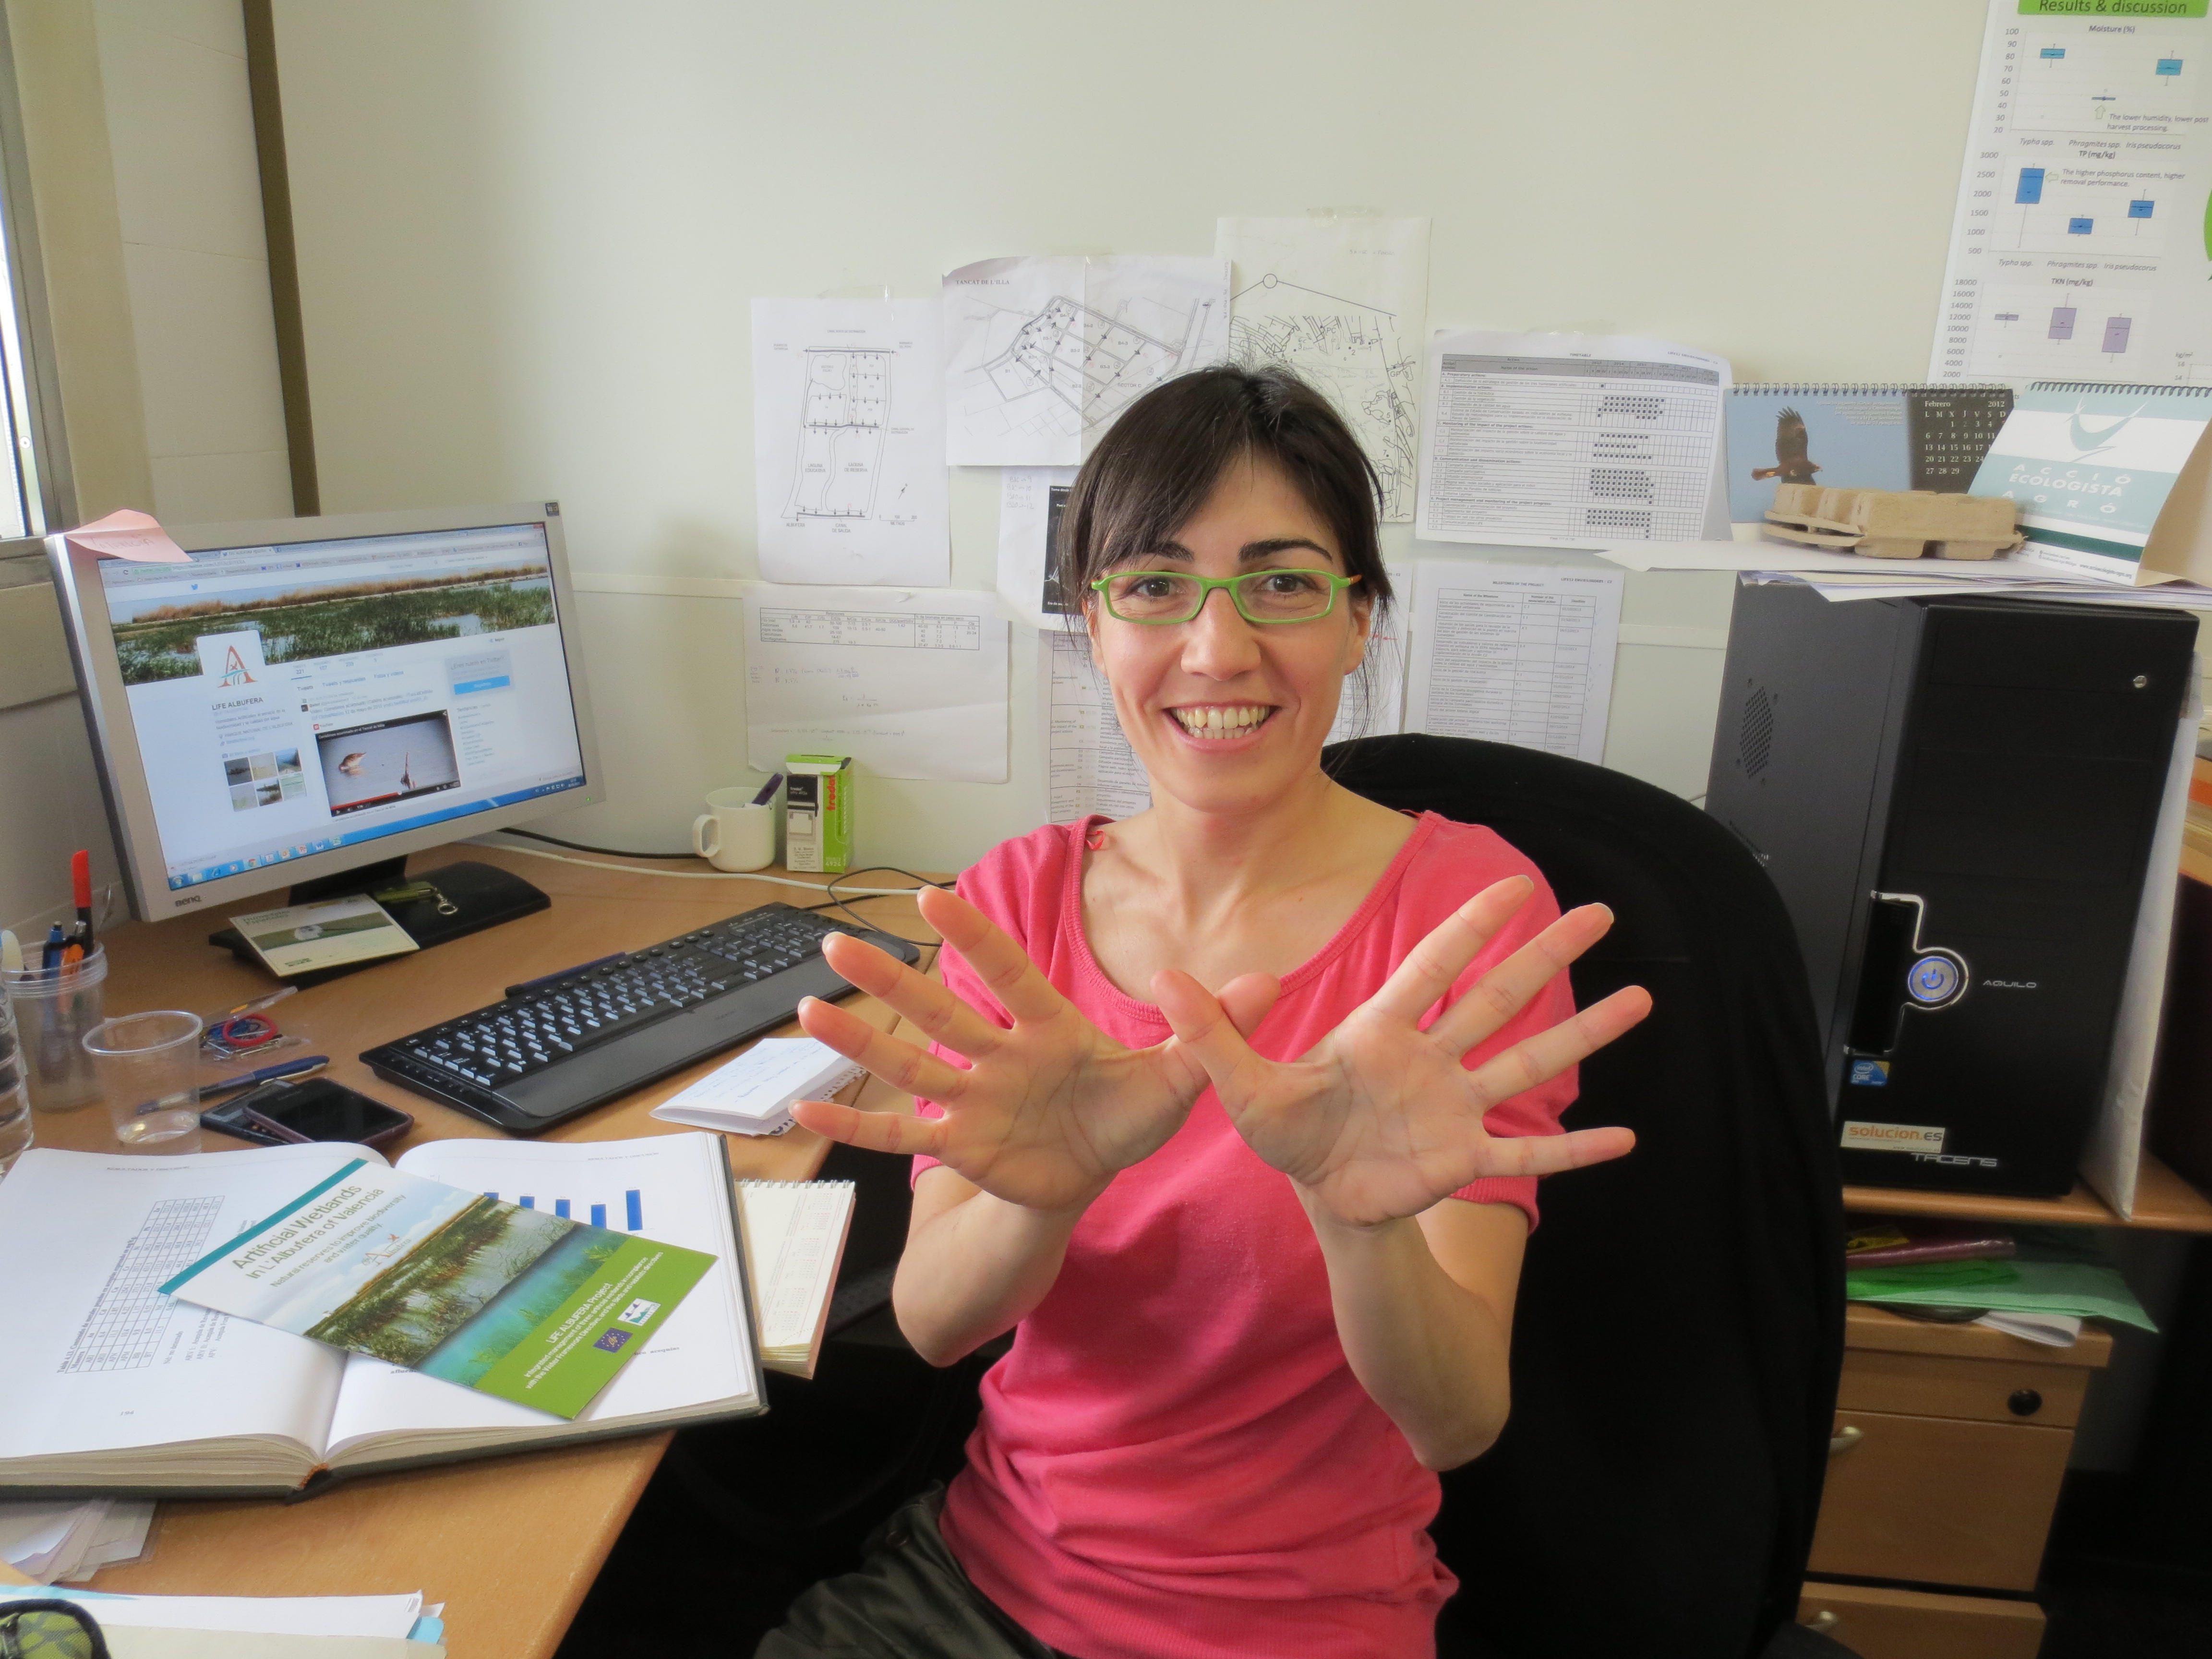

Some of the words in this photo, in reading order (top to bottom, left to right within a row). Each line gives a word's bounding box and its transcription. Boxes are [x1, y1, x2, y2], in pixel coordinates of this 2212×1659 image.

[2039, 0, 2091, 12] Results
[2095, 0, 2107, 12] &
[2112, 0, 2187, 14] discussion
[2089, 25, 2122, 33] Moisture
[2123, 25, 2136, 34] (%)
[2143, 115, 2172, 123] humidity,
[2068, 139, 2107, 149] Phragmites
[2088, 150, 2116, 160] (mg/kg)
[2075, 168, 2096, 178] higher
[2096, 169, 2135, 179] phosphorus
[2164, 172, 2186, 180] higher
[2060, 177, 2086, 185] removal
[2087, 179, 2130, 188] performance.
[2066, 278, 2093, 287] (mg/kg)
[2008, 473, 2123, 497] ECOLOGISTA
[212, 702, 227, 710] LIFE
[228, 697, 264, 709] ALBUFERA
[1983, 979, 2037, 989] AQUILO
[322, 1219, 339, 1230] of
[332, 1189, 385, 1220] Valencia
[232, 1227, 300, 1270] Artificial
[289, 1185, 362, 1229] Wetlands
[269, 1267, 301, 1288] Natural
[298, 1245, 334, 1270] reserves
[329, 1239, 342, 1248] to
[365, 1194, 407, 1222] biodiversity
[324, 1252, 340, 1263] and
[337, 1238, 360, 1254] water
[546, 1330, 564, 1344] LIFE
[559, 1302, 593, 1333] ALBUFERA
[587, 1282, 613, 1304] Project
[524, 1354, 551, 1378] Integrated
[547, 1329, 578, 1356] management
[524, 1379, 538, 1389] with
[541, 1358, 560, 1372] Water
[555, 1334, 584, 1359] Framework
